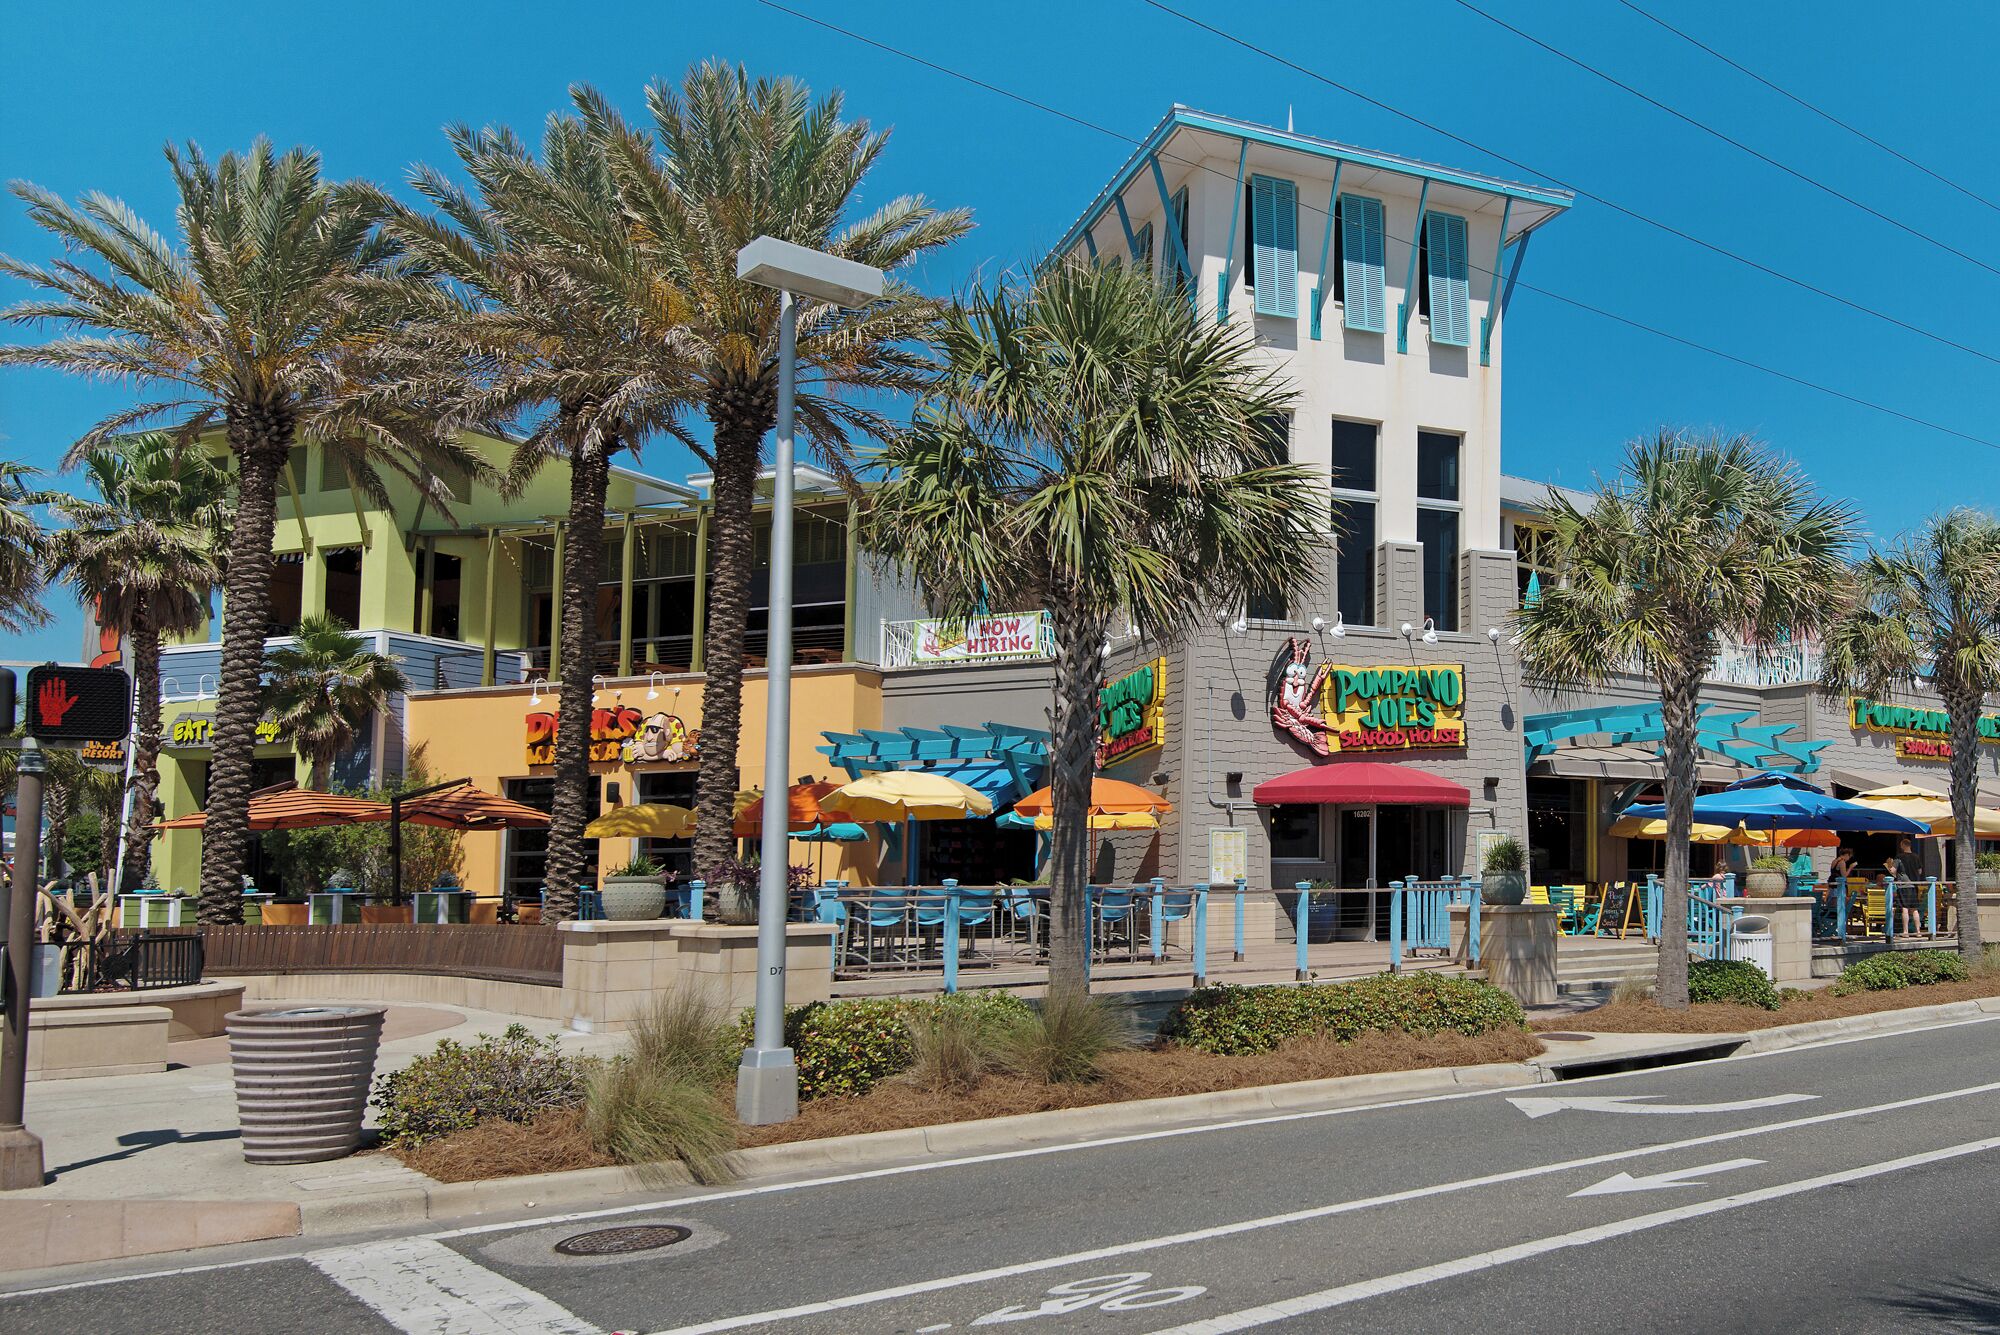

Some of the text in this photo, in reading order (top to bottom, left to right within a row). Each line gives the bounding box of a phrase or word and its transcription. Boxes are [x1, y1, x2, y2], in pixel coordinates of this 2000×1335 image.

[980, 618, 1020, 636] NOW
[967, 634, 1033, 654] HIRING
[1332, 669, 1460, 713] POMPANO
[1359, 697, 1437, 728] JOE'S
[173, 719, 206, 742] EAT
[1339, 728, 1460, 748] SEAFOOD HOUSE
[82, 747, 124, 759] RESORT
[770, 966, 783, 976] D7
